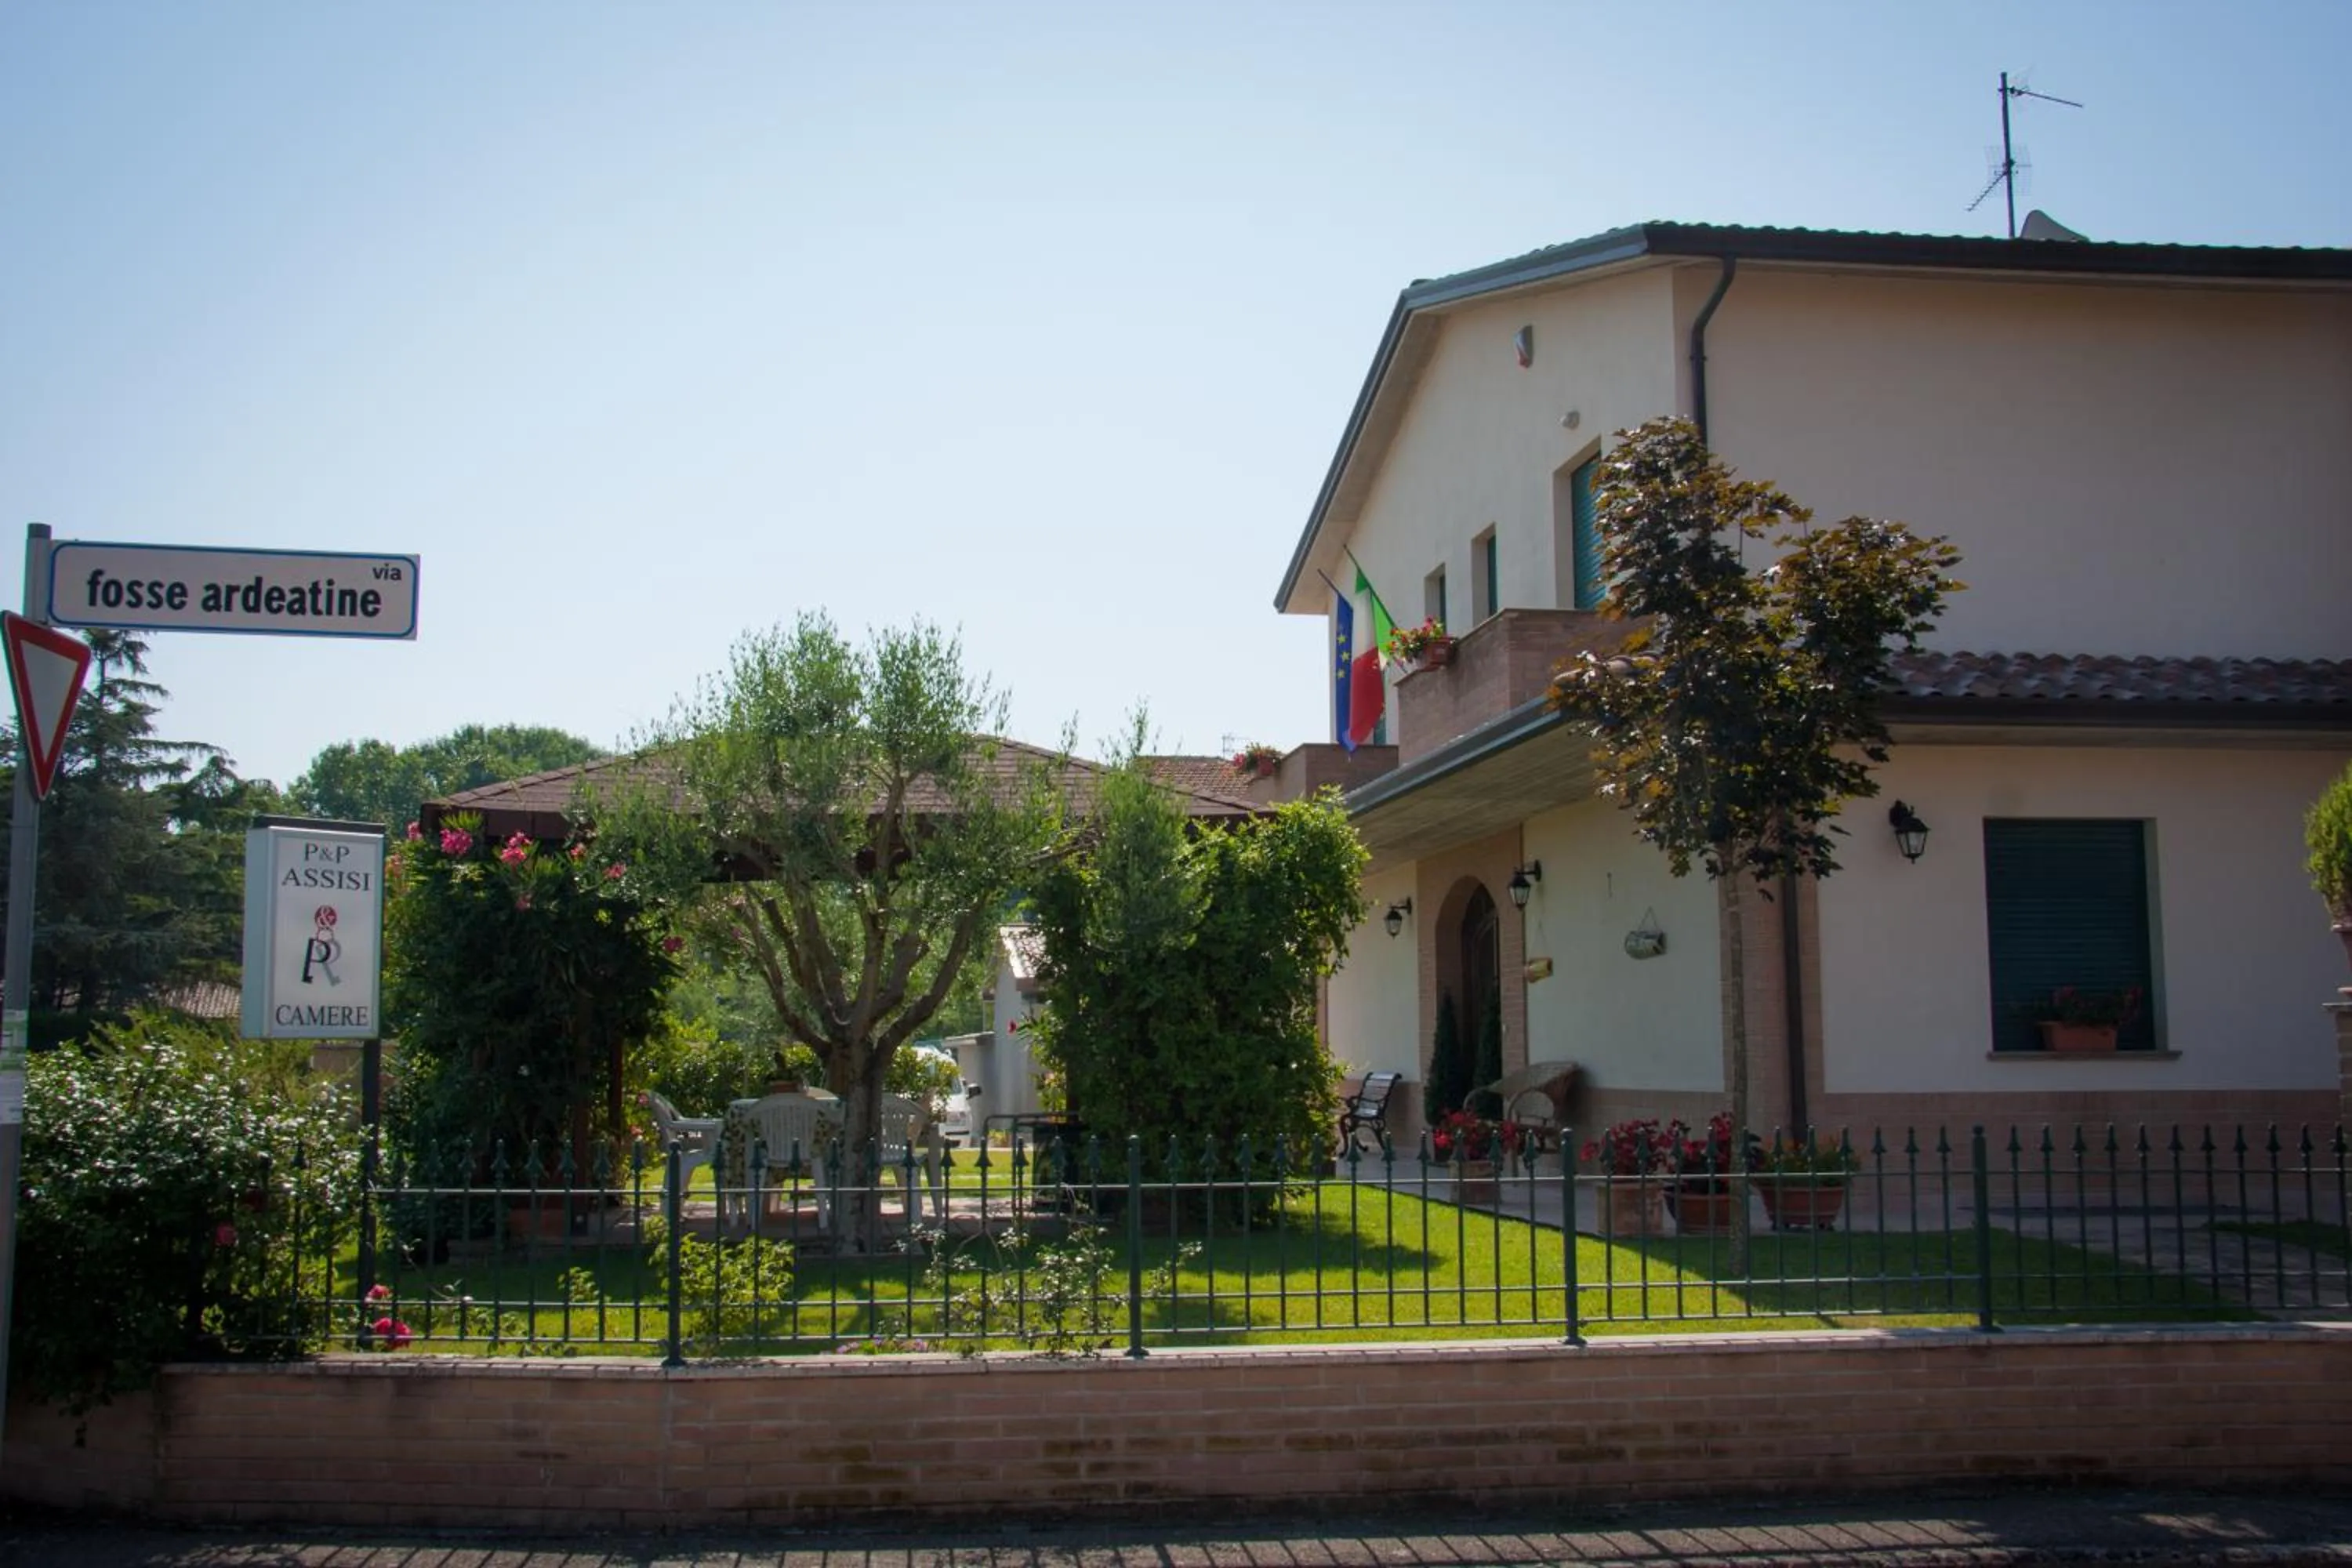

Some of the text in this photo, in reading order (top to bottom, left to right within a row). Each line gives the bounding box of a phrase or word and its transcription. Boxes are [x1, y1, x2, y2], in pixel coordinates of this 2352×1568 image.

[372, 563, 401, 581] via
[87, 568, 382, 617] fosse ardeatine
[304, 842, 350, 863] P&P
[282, 868, 371, 891] ASSISI
[275, 1004, 368, 1026] CAMERE
